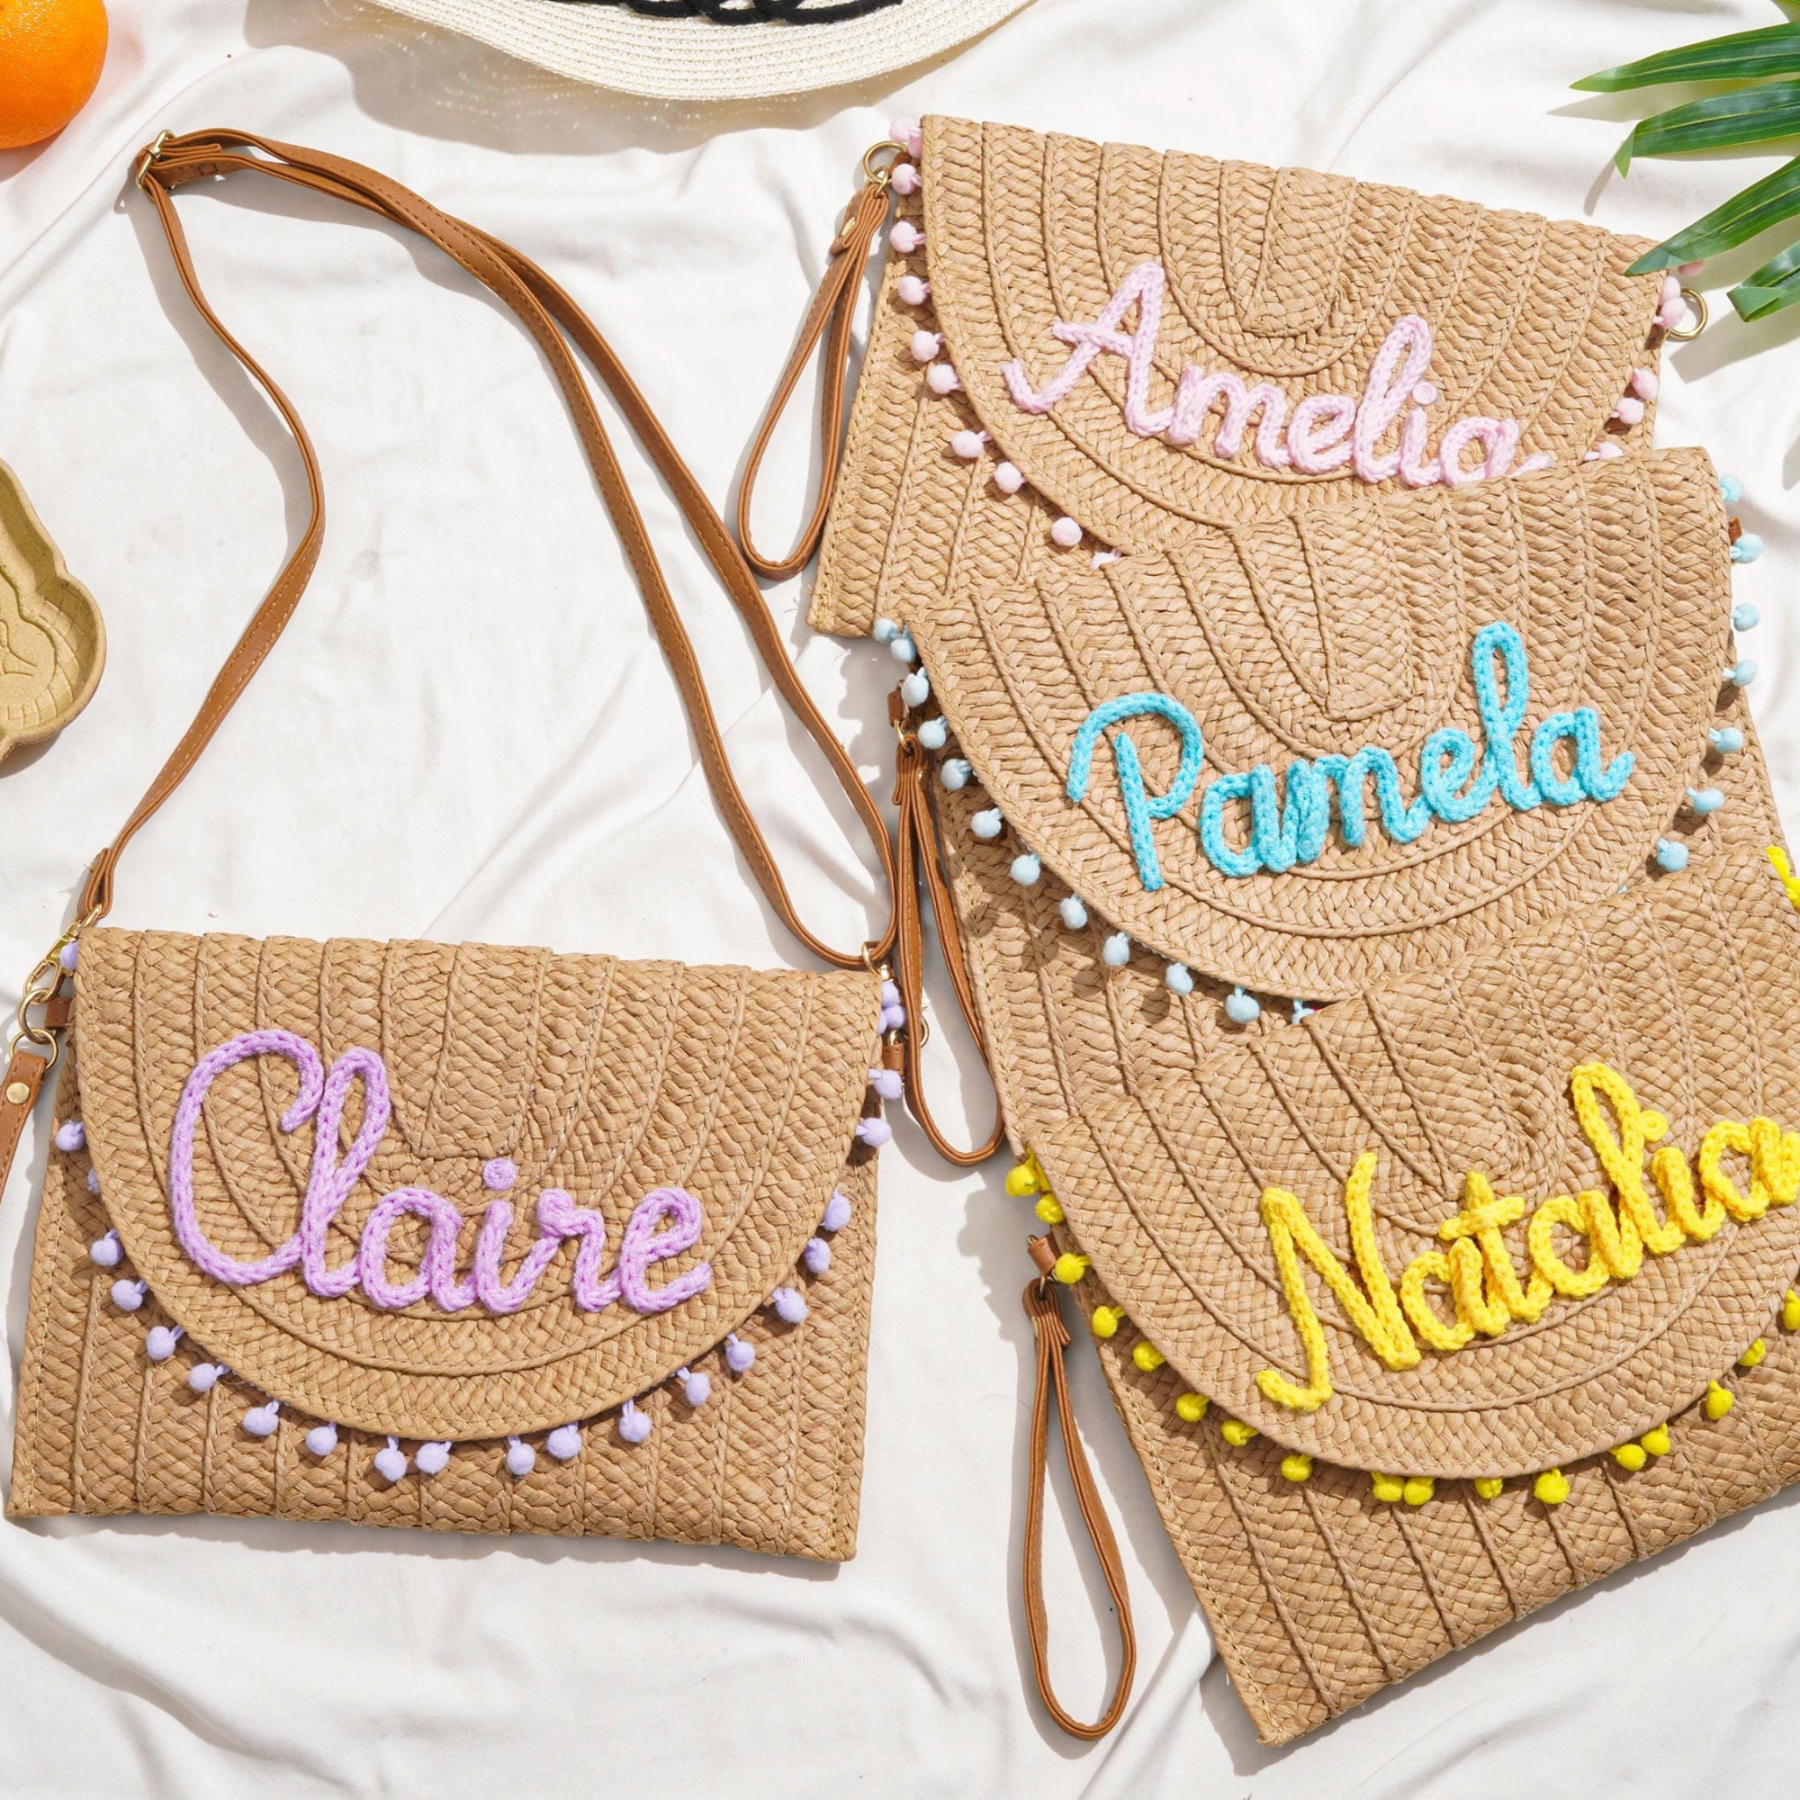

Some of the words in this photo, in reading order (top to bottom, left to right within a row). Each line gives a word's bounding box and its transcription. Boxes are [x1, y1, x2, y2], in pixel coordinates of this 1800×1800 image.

[1002, 260, 1554, 488] Amelia
[1066, 622, 1635, 892] Pamela
[169, 1029, 712, 1315] Claire
[1256, 1061, 1800, 1413] Natalia
